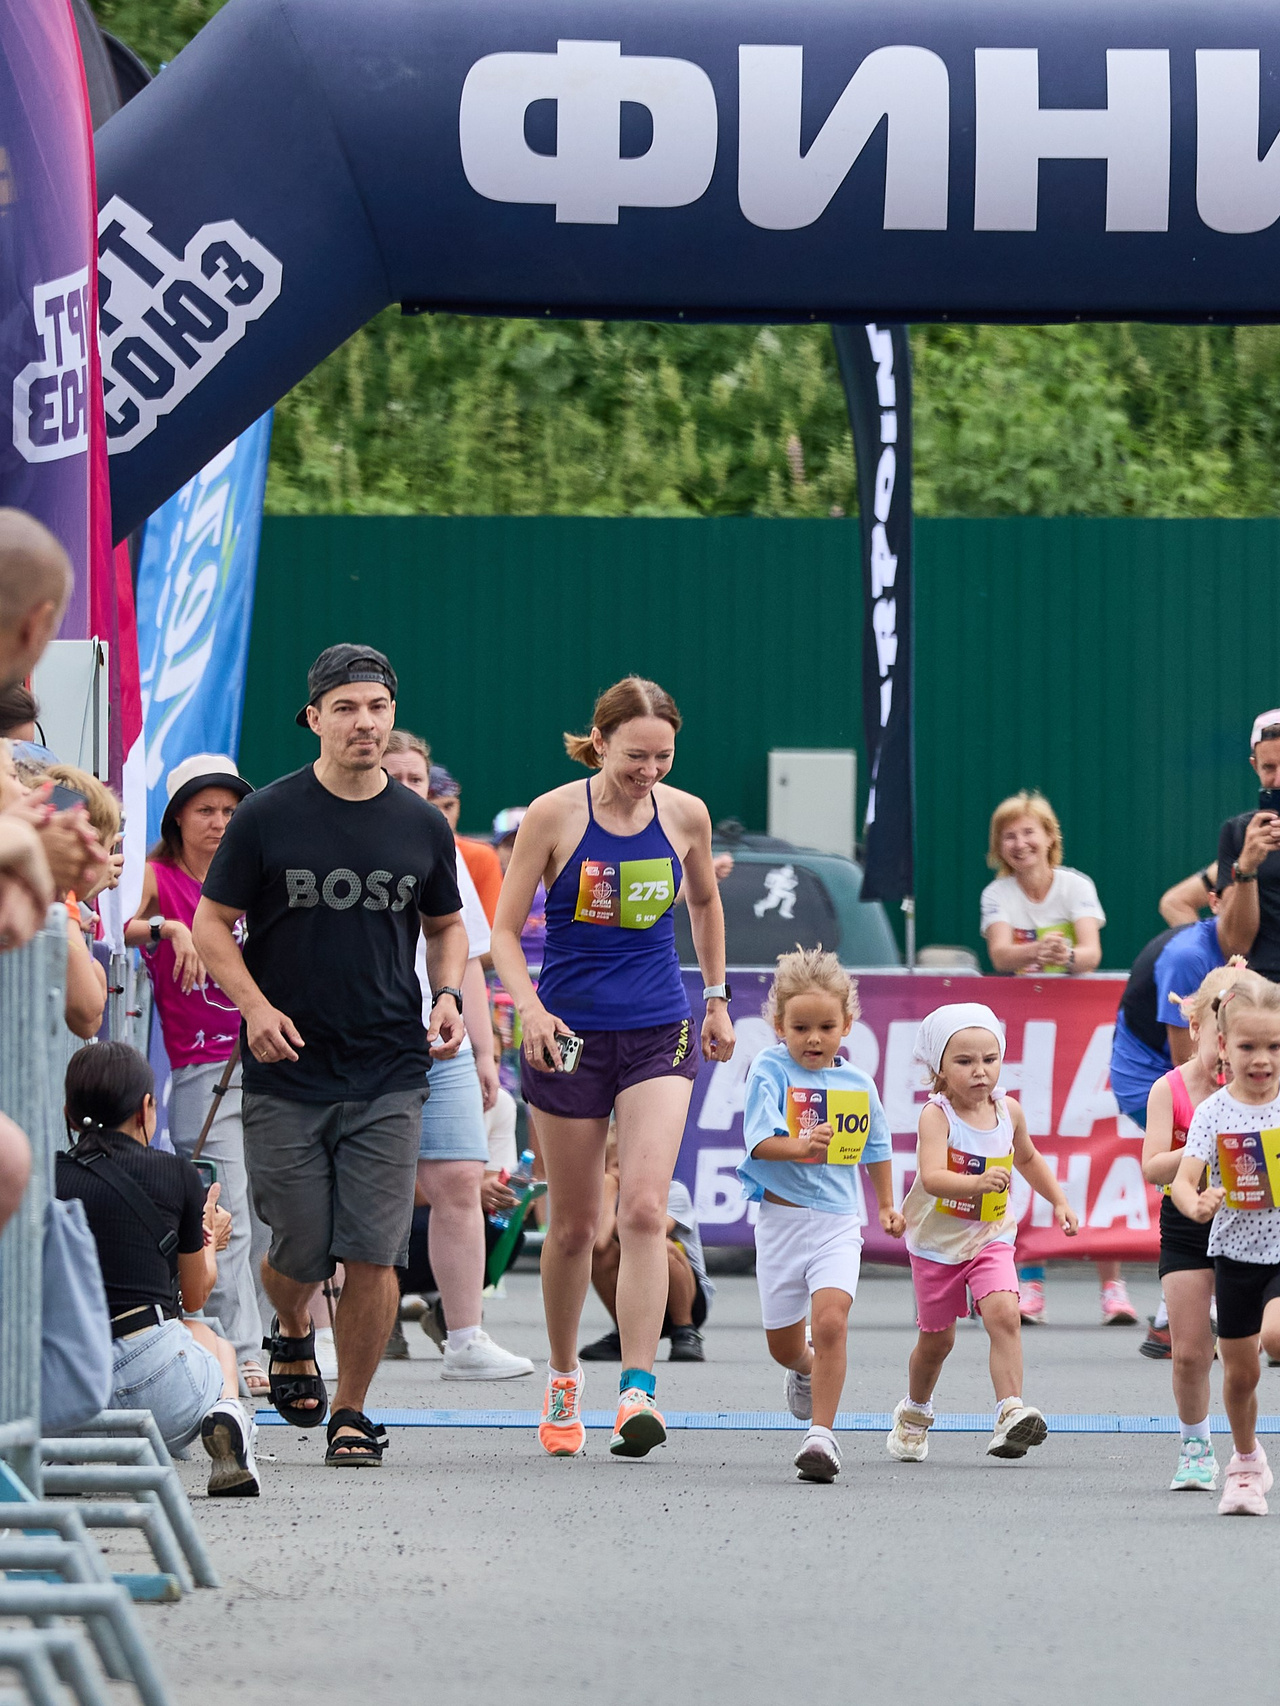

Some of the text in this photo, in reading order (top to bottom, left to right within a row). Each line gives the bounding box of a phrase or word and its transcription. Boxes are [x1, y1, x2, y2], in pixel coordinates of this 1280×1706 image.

[285, 868, 418, 912] BOSS
[628, 880, 669, 902] 275
[635, 913, 642, 922] 5
[835, 1113, 869, 1133] 100
